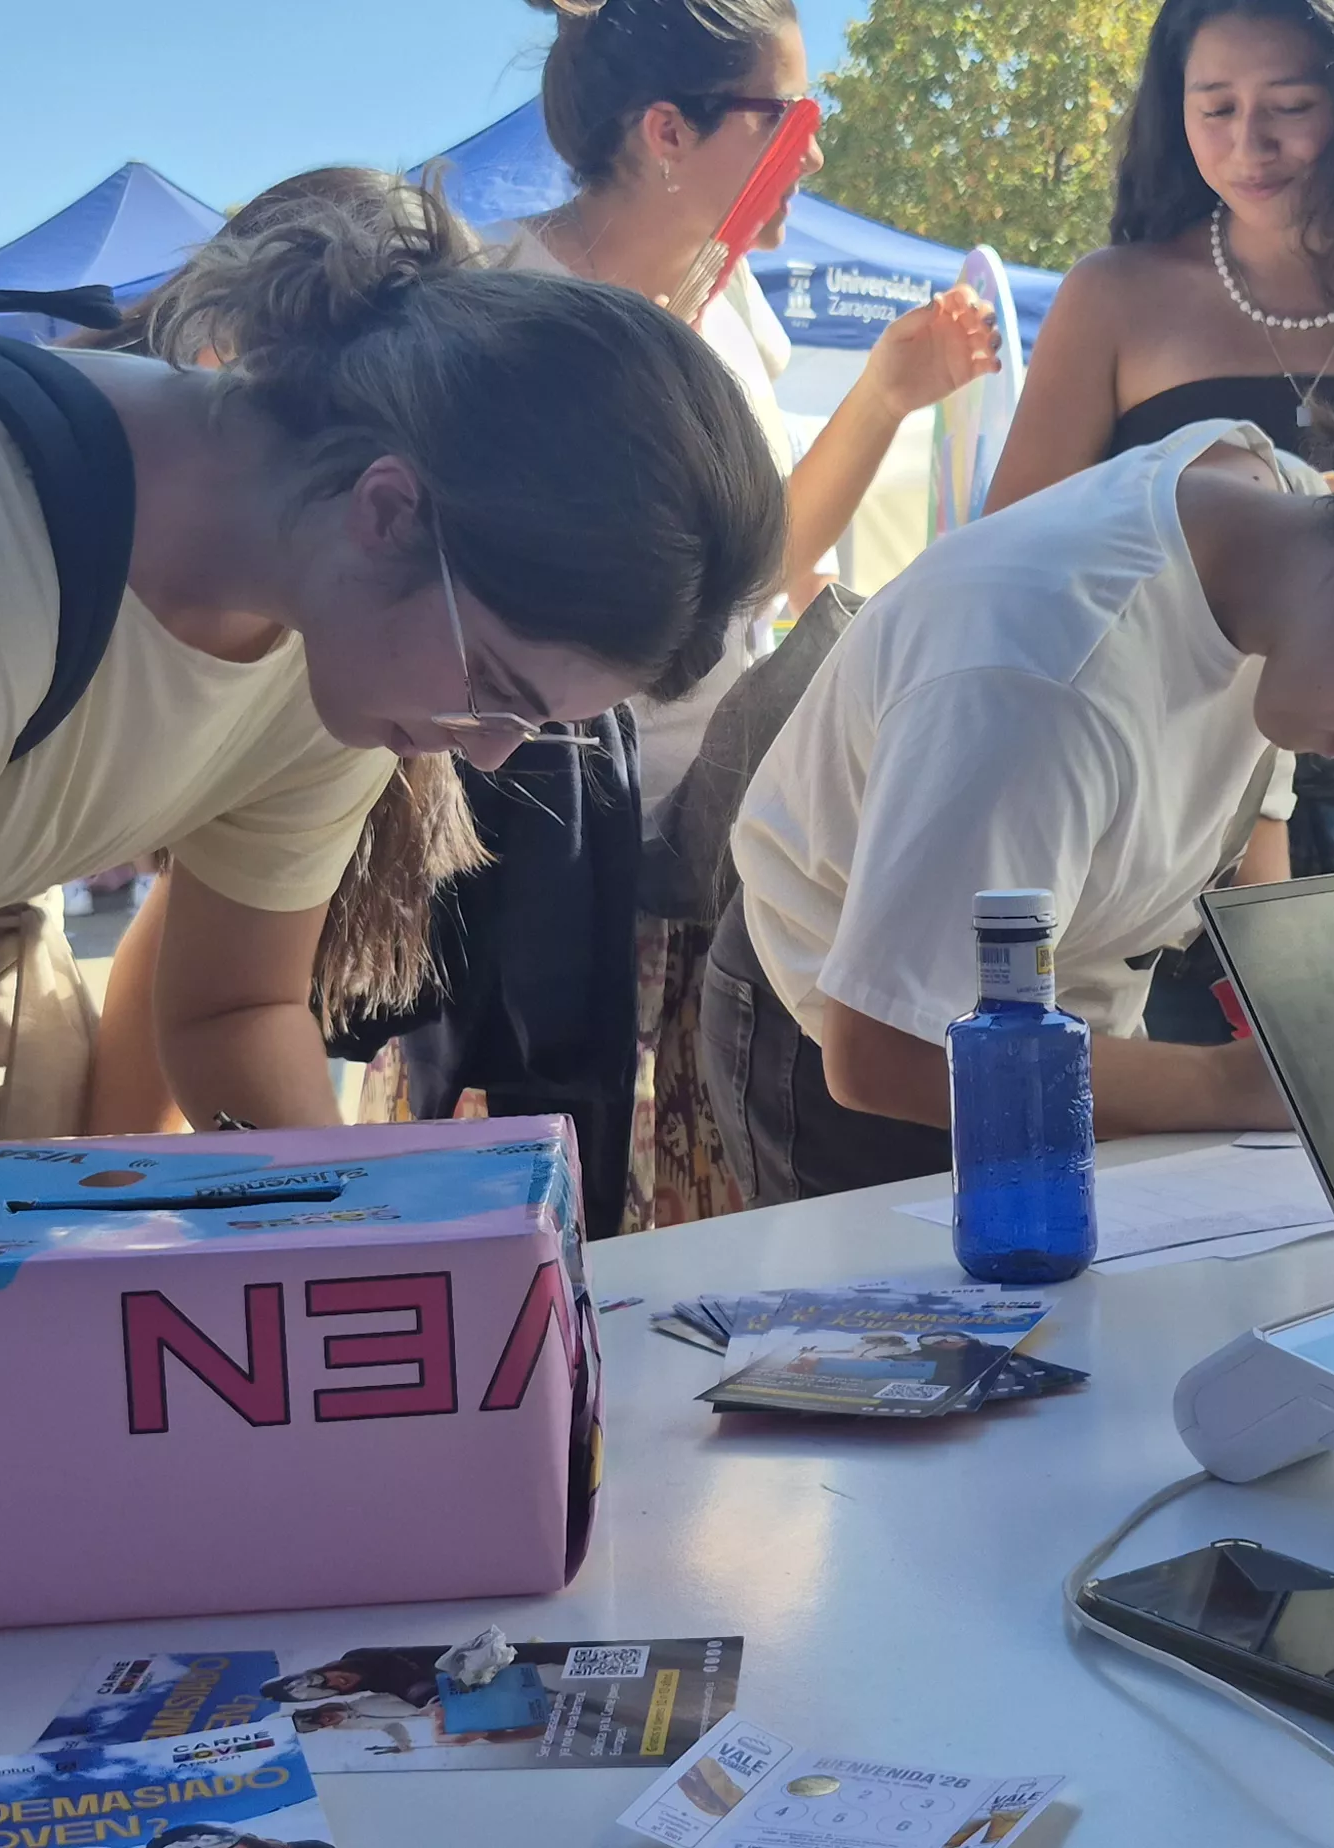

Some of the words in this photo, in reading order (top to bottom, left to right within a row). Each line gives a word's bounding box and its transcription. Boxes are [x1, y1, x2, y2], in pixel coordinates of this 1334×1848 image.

[826, 266, 932, 305] Universidad
[827, 295, 897, 323] Zaragoza
[718, 1742, 769, 1775] VALE
[774, 1806, 790, 1817] 4
[992, 1790, 1045, 1805] VALE
